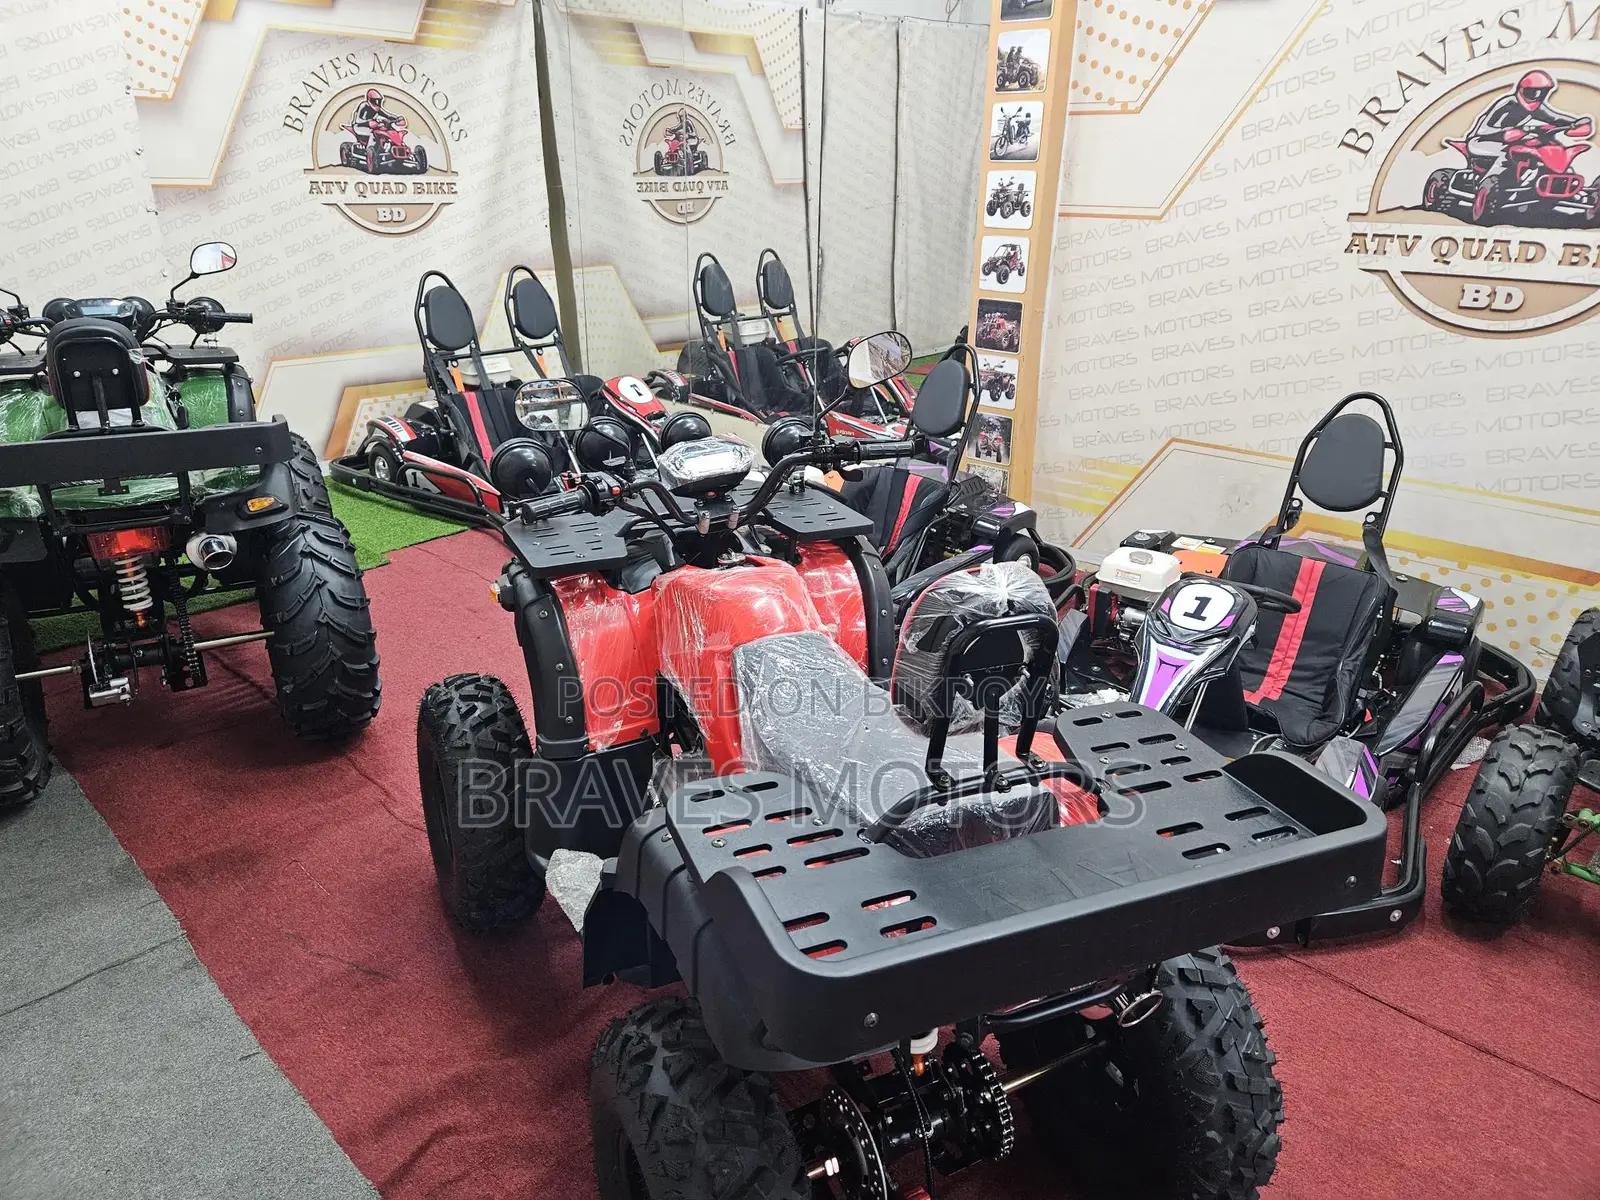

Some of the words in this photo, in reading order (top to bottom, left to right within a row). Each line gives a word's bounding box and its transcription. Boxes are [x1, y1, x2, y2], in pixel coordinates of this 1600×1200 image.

[282, 52, 361, 135] BRAVES
[370, 52, 469, 142] MOTORS
[1337, 7, 1523, 159] BRAVES
[1241, 99, 1341, 141] BRAVES
[1234, 130, 1337, 173] MOTORS
[308, 180, 349, 195] ATV
[353, 181, 409, 199] QUAD
[411, 181, 459, 196] BIKE
[1243, 163, 1342, 201] BRAVES
[376, 206, 407, 223] BD
[1145, 220, 1231, 256] BRAVES
[1236, 194, 1339, 232] MOTORS
[1057, 220, 1133, 251] BRAVES
[1245, 225, 1342, 262] BRAVES
[1344, 232, 1423, 257] ATV
[1431, 234, 1547, 266] QUAD
[1053, 246, 1132, 277] MOTORS
[1062, 273, 1137, 302] BRAVES
[1141, 251, 1230, 286] MOTORS
[1148, 278, 1233, 310] BRAVES
[1238, 256, 1340, 290] MOTORS
[1459, 283, 1526, 312] BD
[1057, 300, 1135, 329] MOTORS
[1248, 287, 1344, 319] BRAVES
[1065, 326, 1140, 352] BRAVES
[1144, 308, 1233, 338] MOTORS
[1151, 335, 1236, 362] BRAVES
[1240, 316, 1341, 347] MOTORS
[1060, 352, 1139, 378] MOTORS
[1249, 348, 1345, 374] BRAVES
[1358, 358, 1468, 387] BRAVES
[1068, 378, 1142, 401] BRAVES
[1147, 364, 1235, 390] MOTORS
[1154, 389, 1238, 413] BRAVES
[1242, 374, 1343, 401] MOTORS
[1064, 403, 1141, 425] MOTORS
[1072, 428, 1145, 449] BRAVES
[1150, 418, 1237, 441] MOTORS
[1182, 596, 1213, 622] 1
